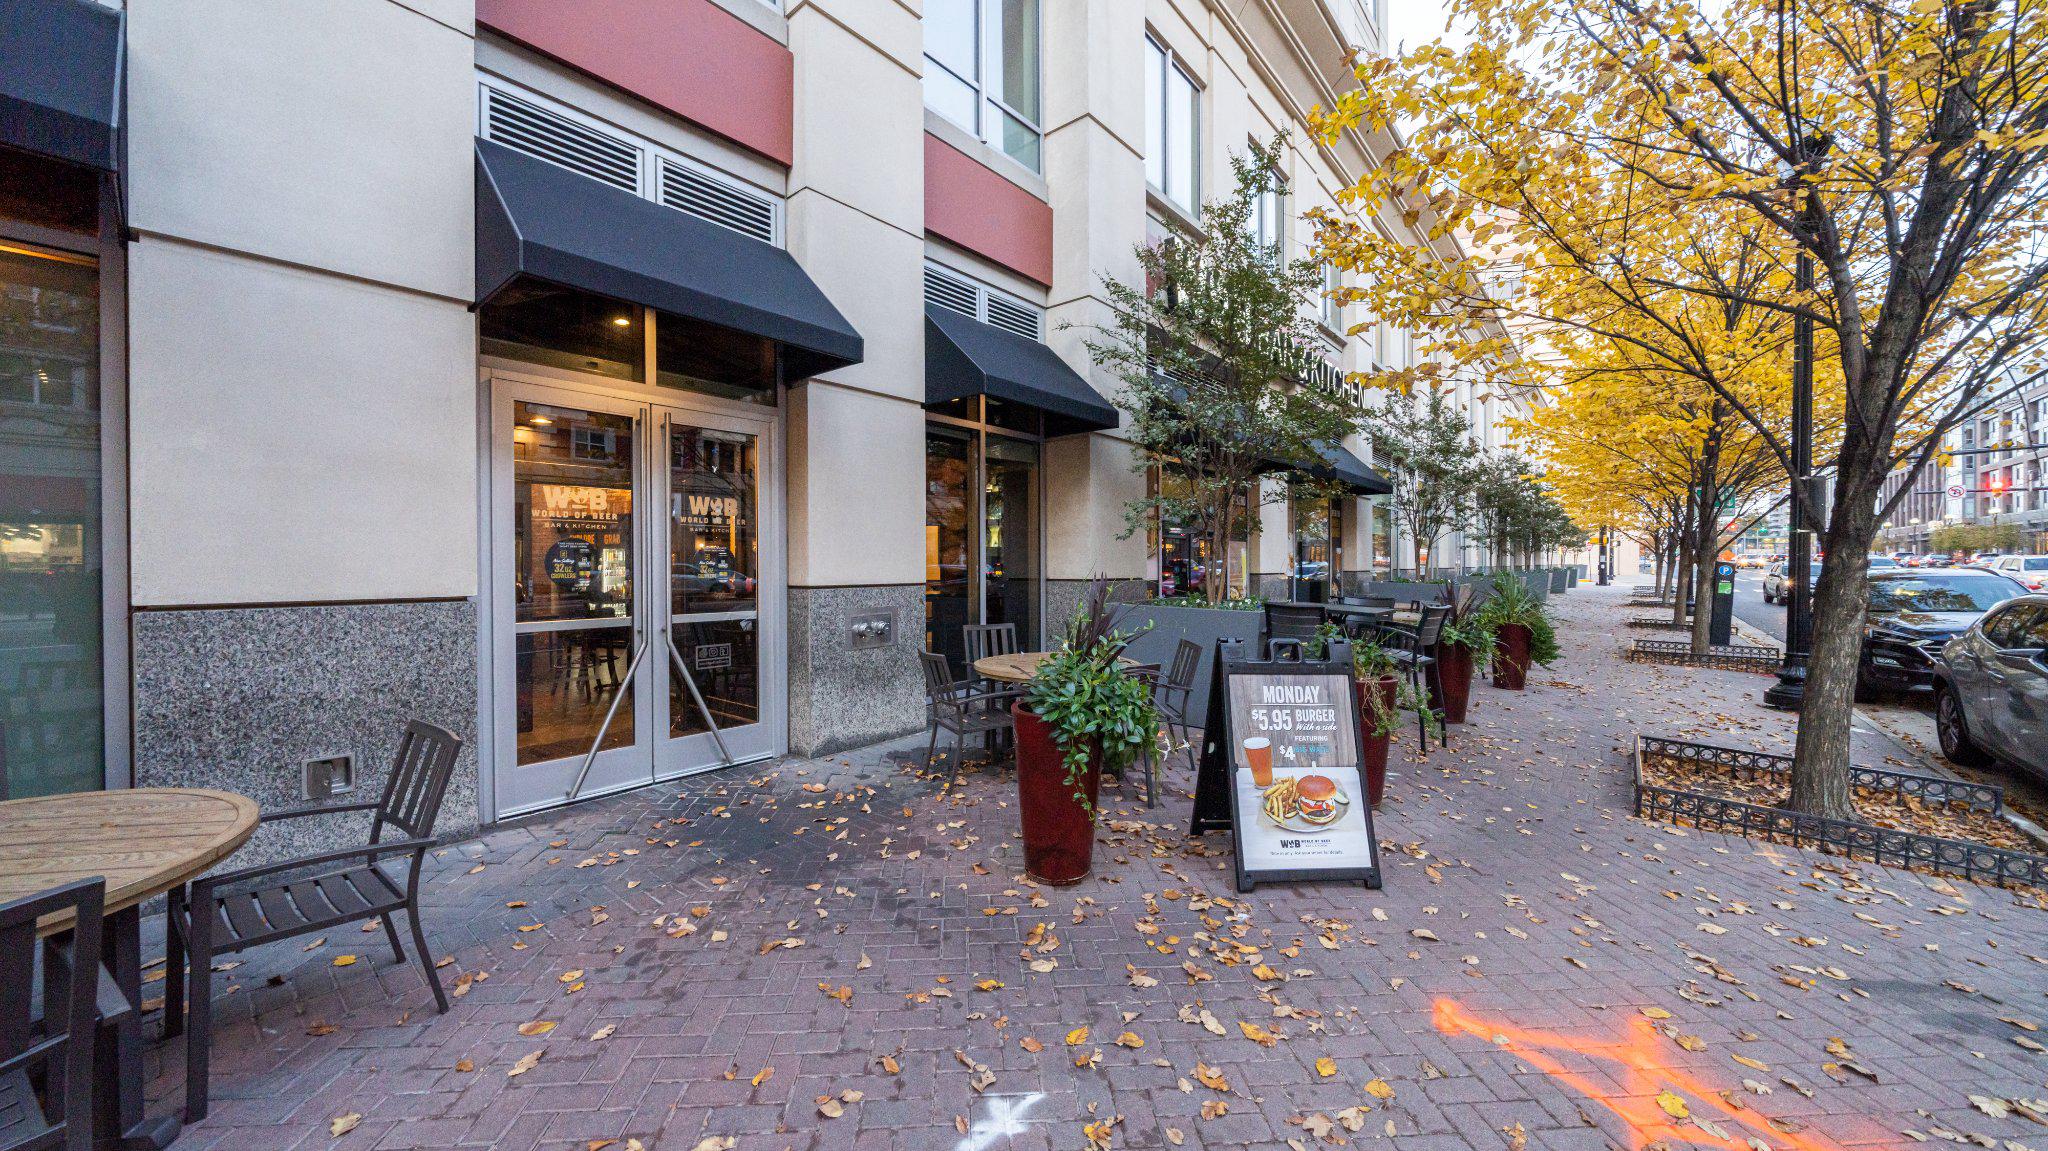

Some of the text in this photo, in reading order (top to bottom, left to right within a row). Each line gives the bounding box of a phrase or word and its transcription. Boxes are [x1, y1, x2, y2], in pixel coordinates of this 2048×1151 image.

[532, 510, 569, 518] WORLD
[574, 511, 587, 519] OF
[680, 516, 709, 524] WORLD
[726, 518, 746, 526] BER
[603, 534, 621, 545] GRAB
[554, 563, 565, 573] 32
[1262, 685, 1320, 704] MONDAY
[1251, 708, 1336, 731] $5.95 BURGER
[1295, 722, 1315, 731] With
[1322, 722, 1338, 731] side
[1279, 744, 1296, 761] $4
